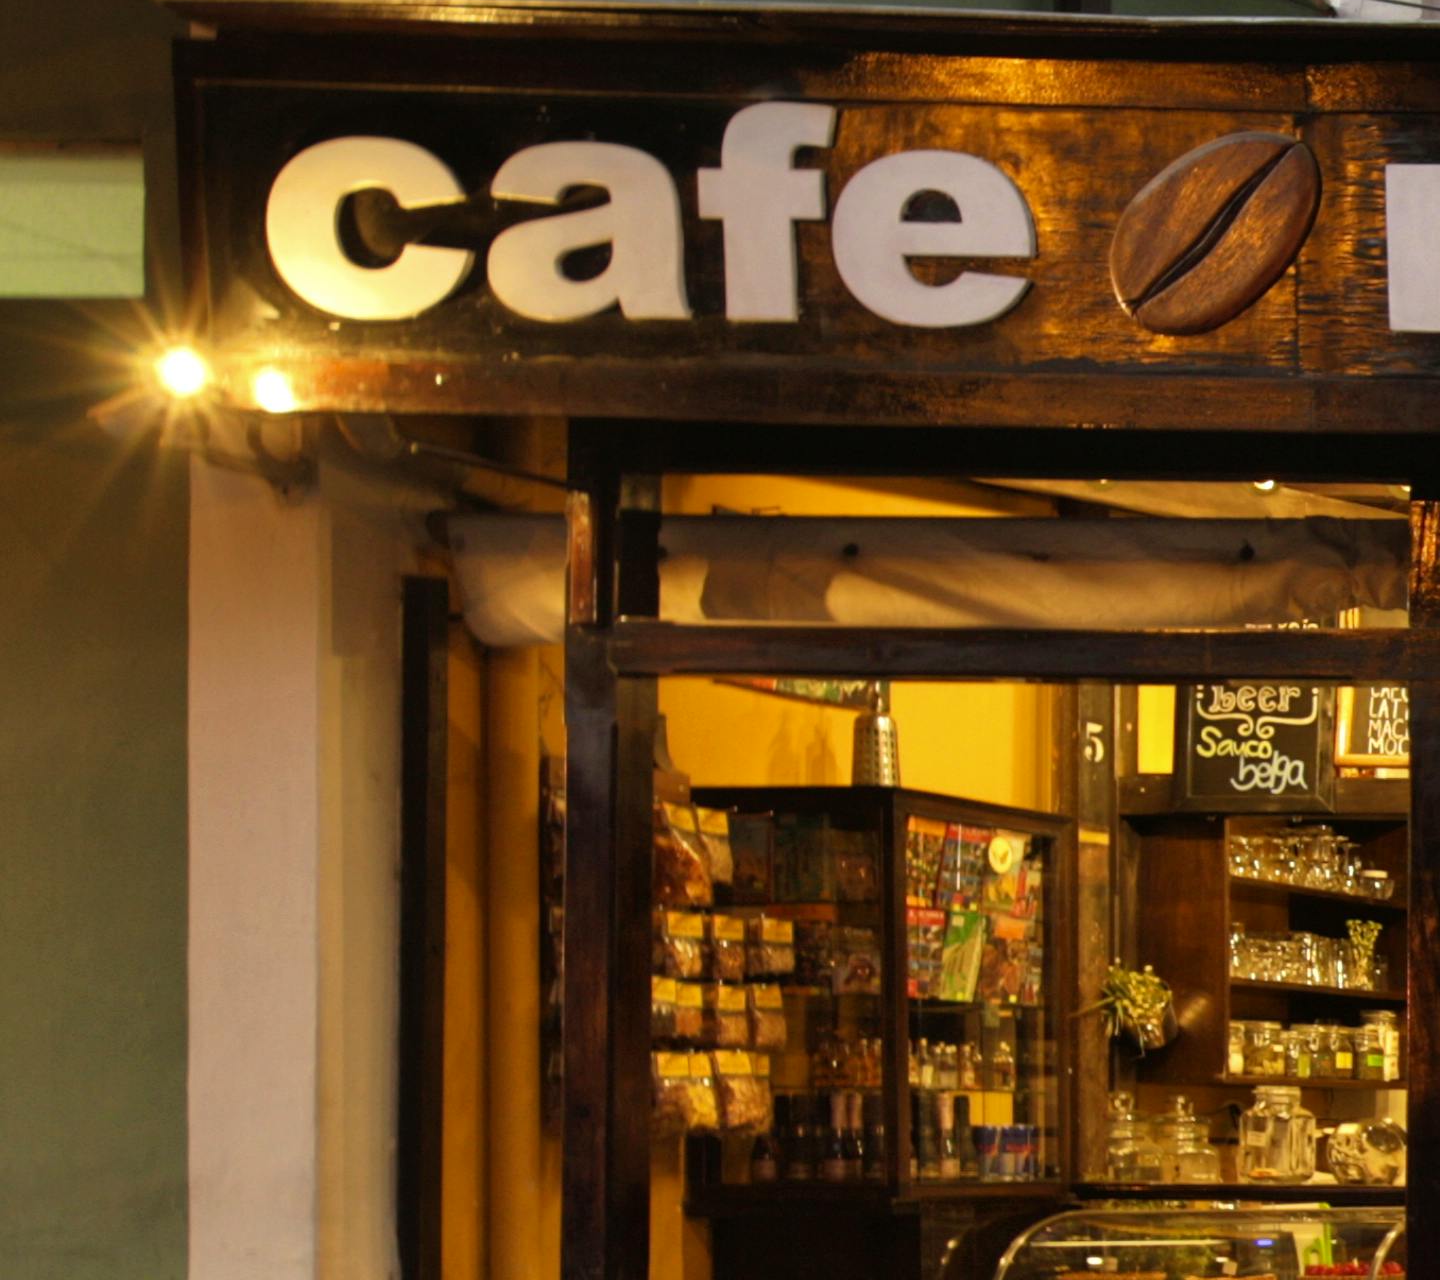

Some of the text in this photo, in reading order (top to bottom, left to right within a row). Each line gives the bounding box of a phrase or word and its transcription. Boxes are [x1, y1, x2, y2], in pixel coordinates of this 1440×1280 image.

[266, 102, 1037, 327] cafe
[1208, 685, 1301, 713] beer
[1084, 721, 1105, 763] 5
[1196, 725, 1273, 758] Sauco
[1368, 737, 1409, 756] MOC
[1230, 750, 1308, 794] belga
